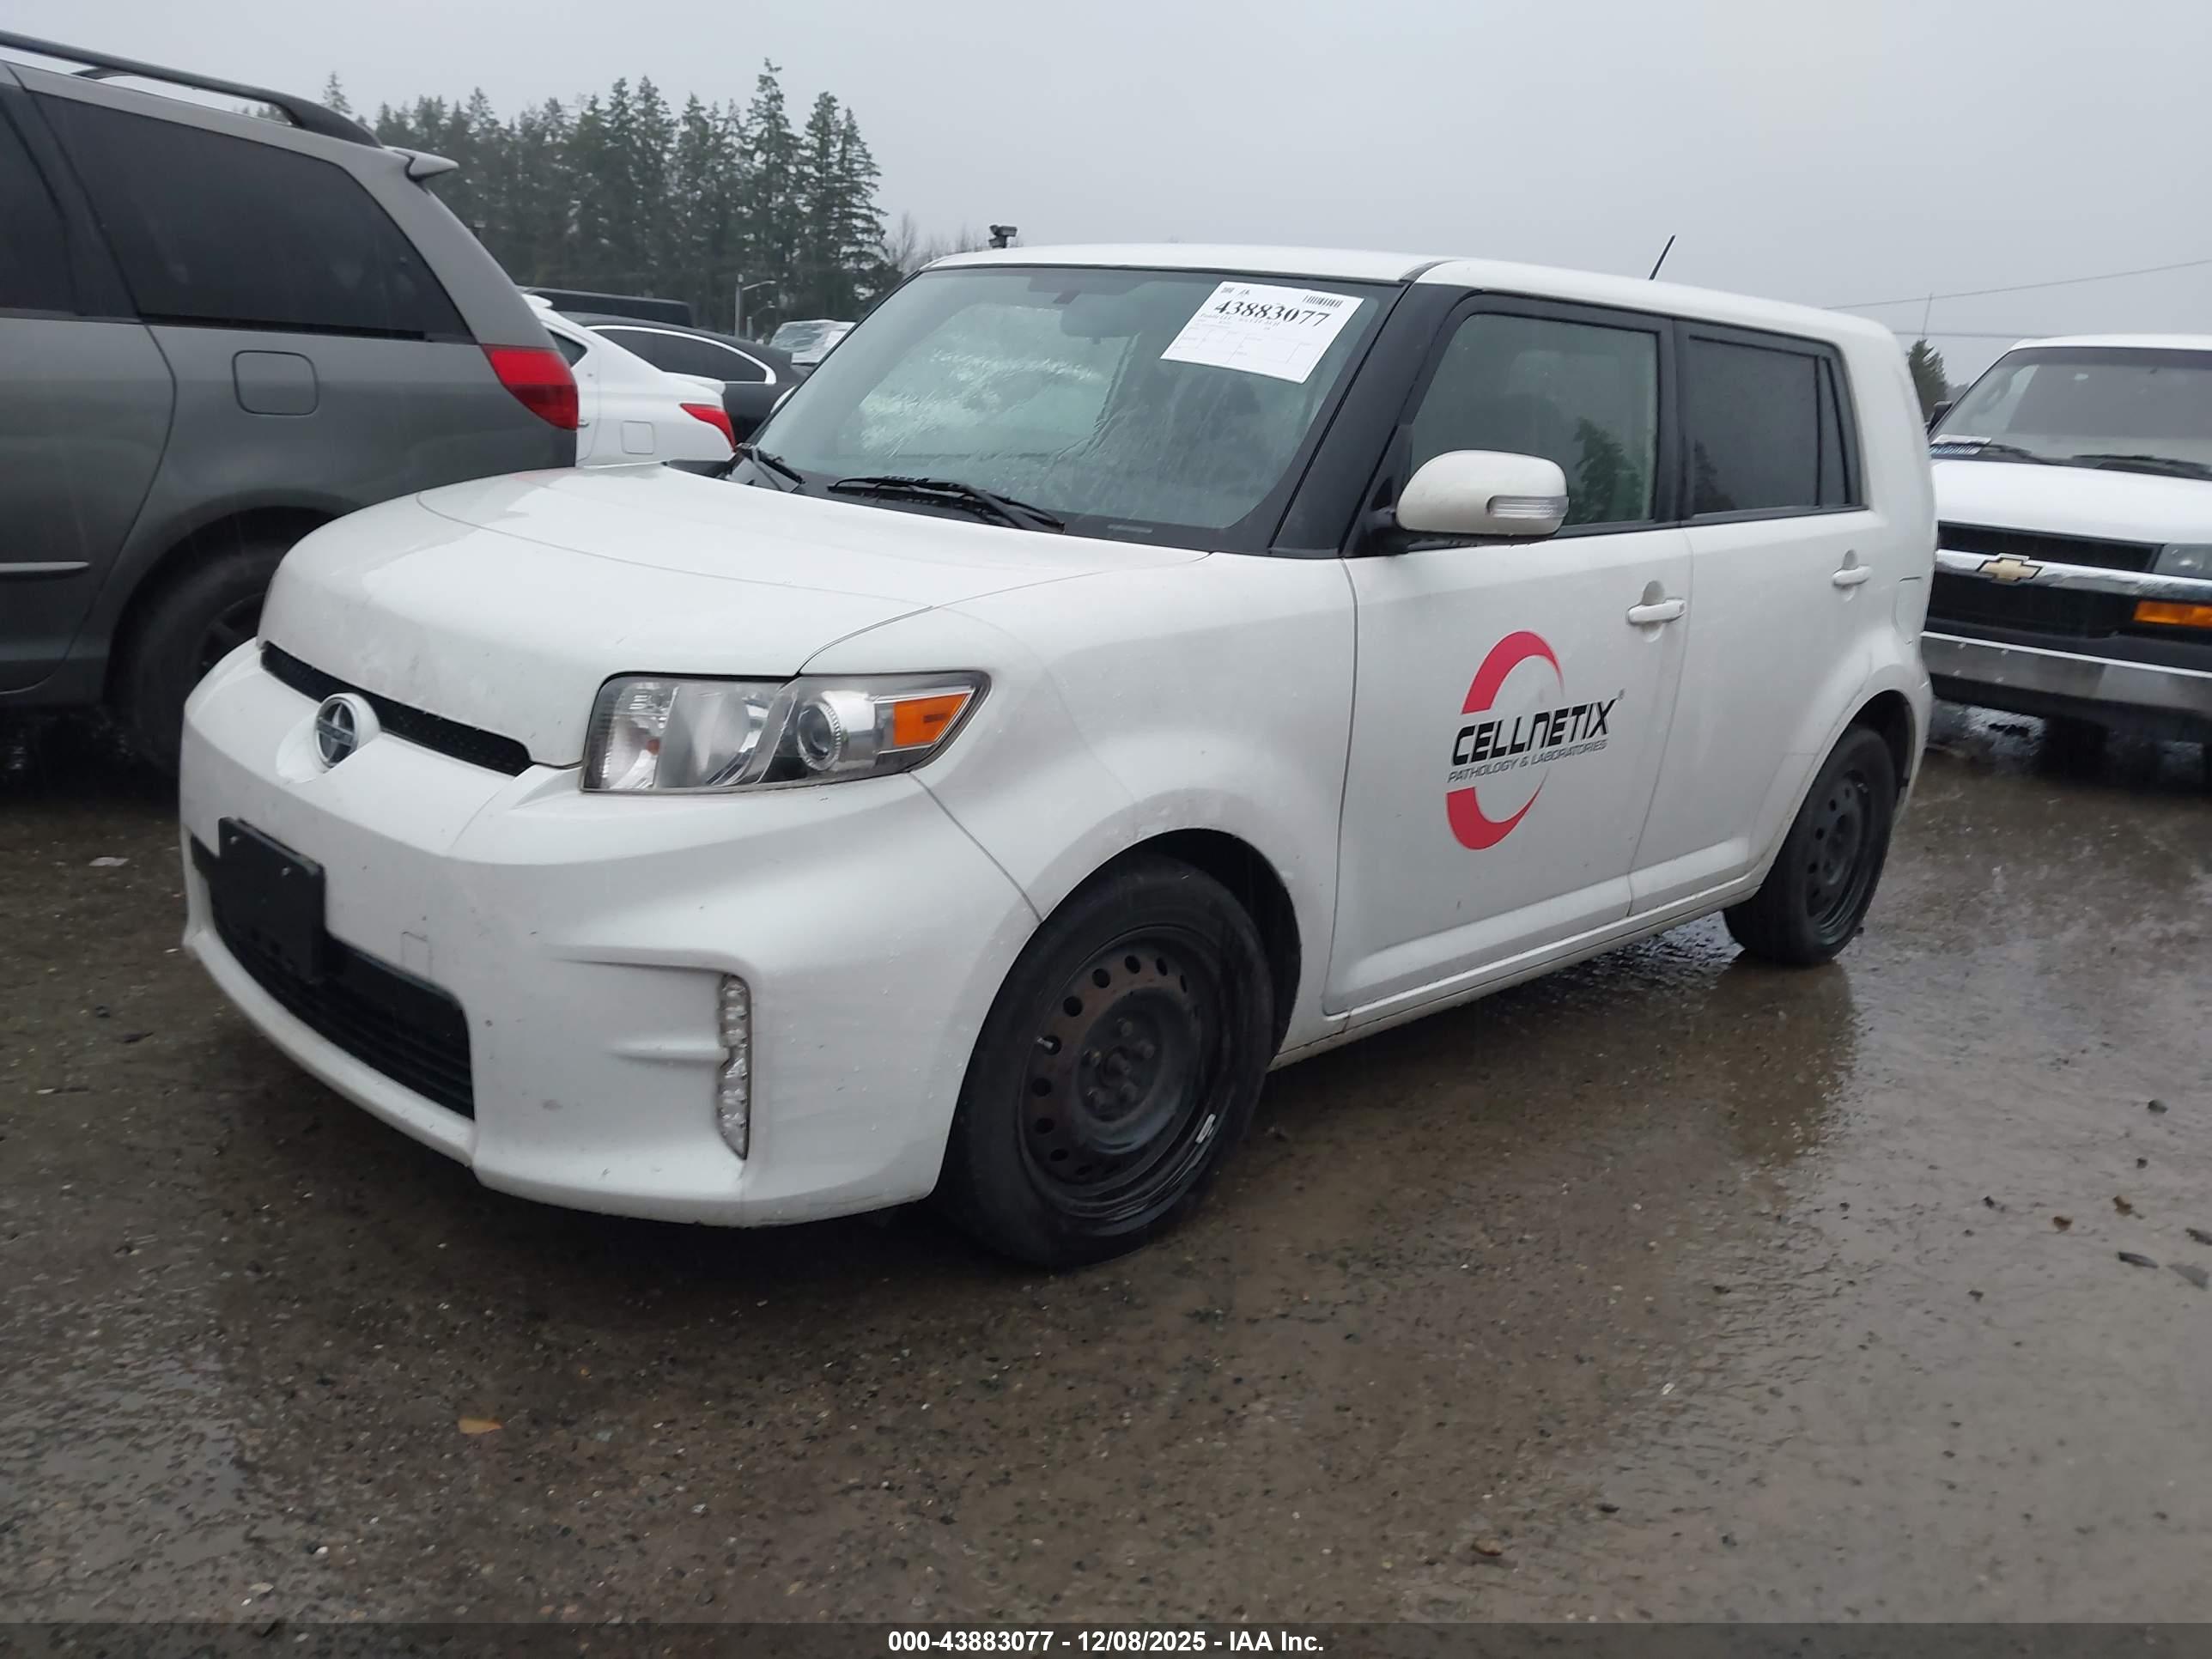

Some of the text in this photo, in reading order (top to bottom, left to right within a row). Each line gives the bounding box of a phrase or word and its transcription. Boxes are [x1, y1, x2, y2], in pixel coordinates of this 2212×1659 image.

[1214, 300, 1331, 327] 43883077
[1452, 698, 1617, 766] CELLNETIX
[1447, 739, 1608, 784] PATHOLOGY & LABORATORIES
